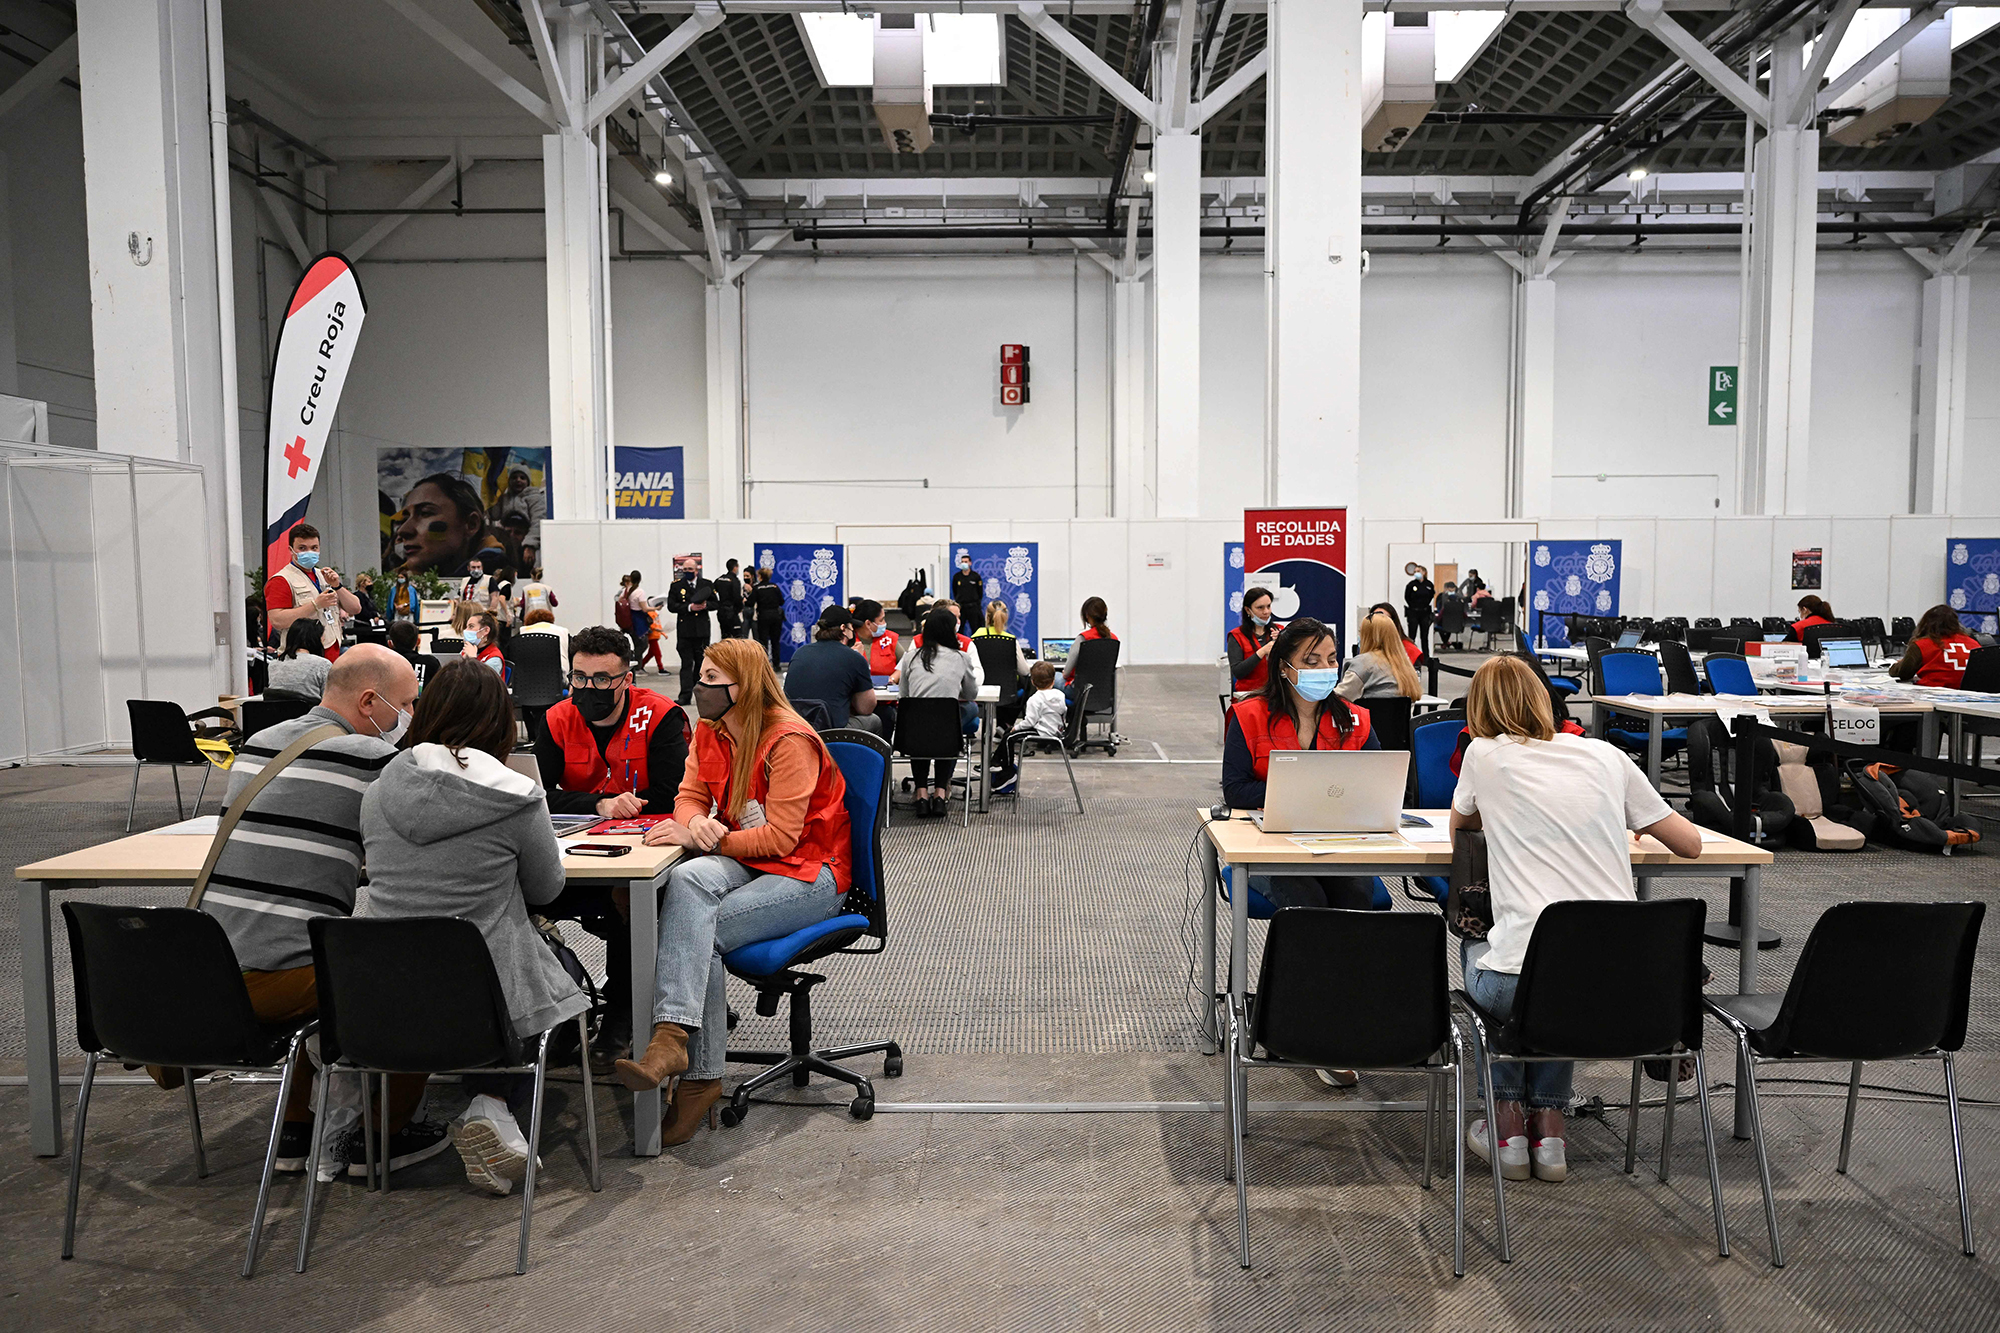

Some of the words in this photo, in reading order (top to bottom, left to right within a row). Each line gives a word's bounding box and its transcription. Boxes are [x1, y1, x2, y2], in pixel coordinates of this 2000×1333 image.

[300, 364, 327, 425] Creu
[318, 301, 347, 359] Roja
[1256, 521, 1341, 533] RECOLLIDA
[1260, 534, 1281, 546] DE
[1284, 534, 1335, 546] DADES
